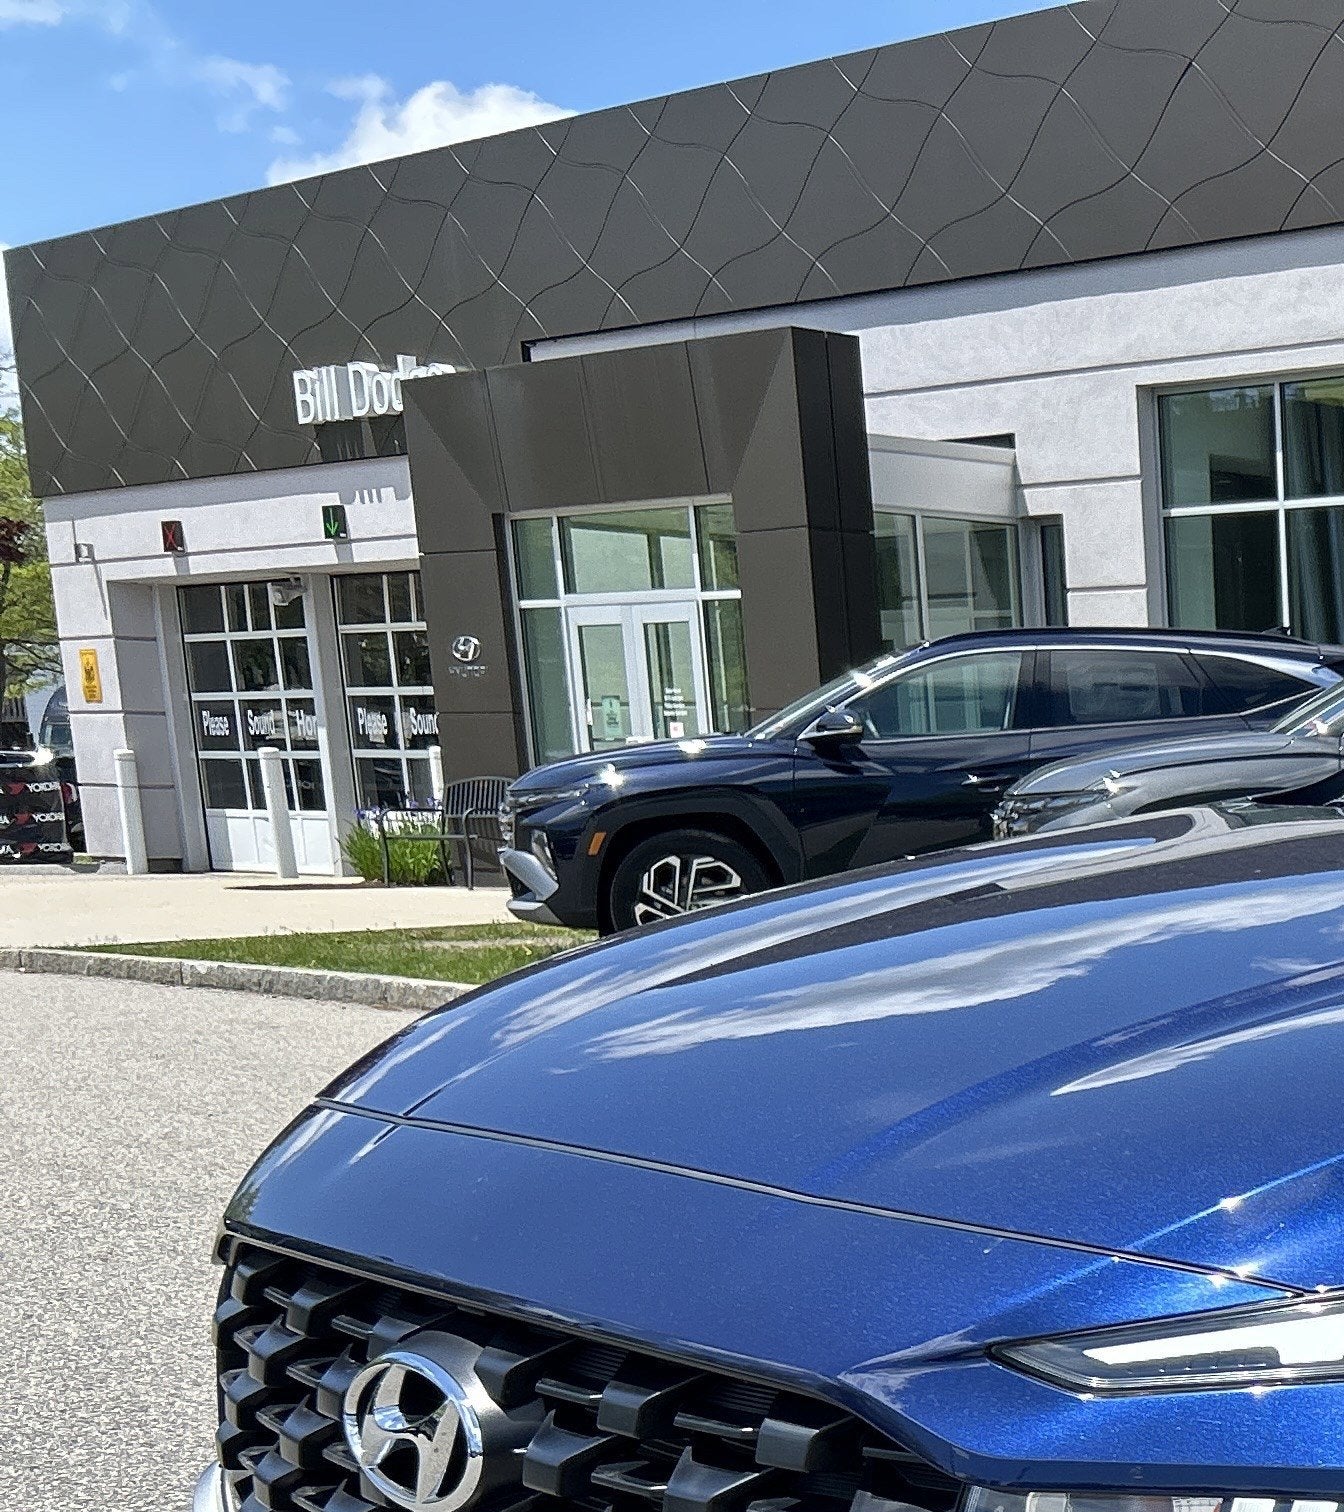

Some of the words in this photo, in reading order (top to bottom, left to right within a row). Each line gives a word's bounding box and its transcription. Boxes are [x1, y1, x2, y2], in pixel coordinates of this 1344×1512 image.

[293, 365, 341, 424] Bill
[347, 354, 456, 418] Dod
[202, 710, 230, 736] Please
[247, 709, 276, 736] Sound
[357, 707, 388, 735] Please
